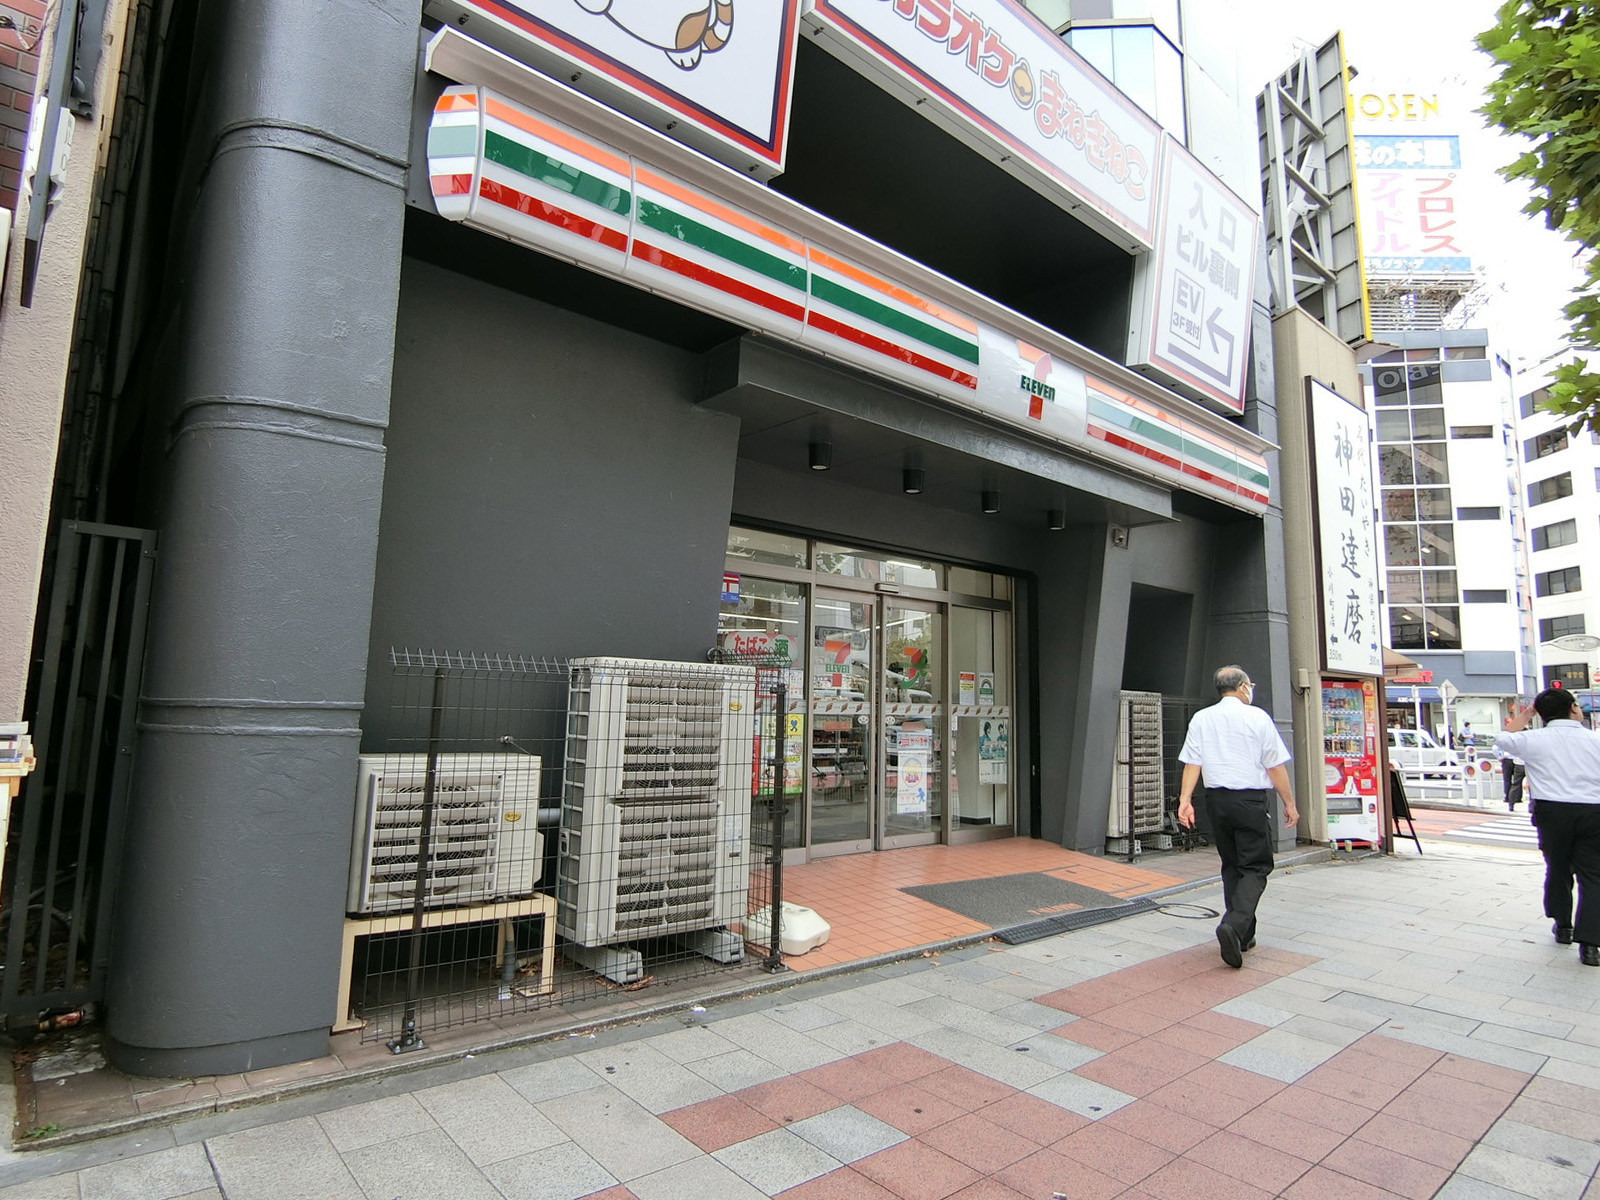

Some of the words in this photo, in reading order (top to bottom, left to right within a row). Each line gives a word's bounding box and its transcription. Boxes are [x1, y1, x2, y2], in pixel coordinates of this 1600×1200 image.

[1034, 70, 1148, 201] まねきねこ
[1189, 180, 1237, 252] 入口
[1367, 173, 1410, 254] アイドル
[1415, 173, 1462, 254] プロレス
[1176, 224, 1241, 300] ビル裏側
[1176, 277, 1202, 314] EV
[1172, 312, 1200, 340] 3F受付
[1334, 421, 1364, 644] 神田達磨
[734, 634, 768, 656] たばこ
